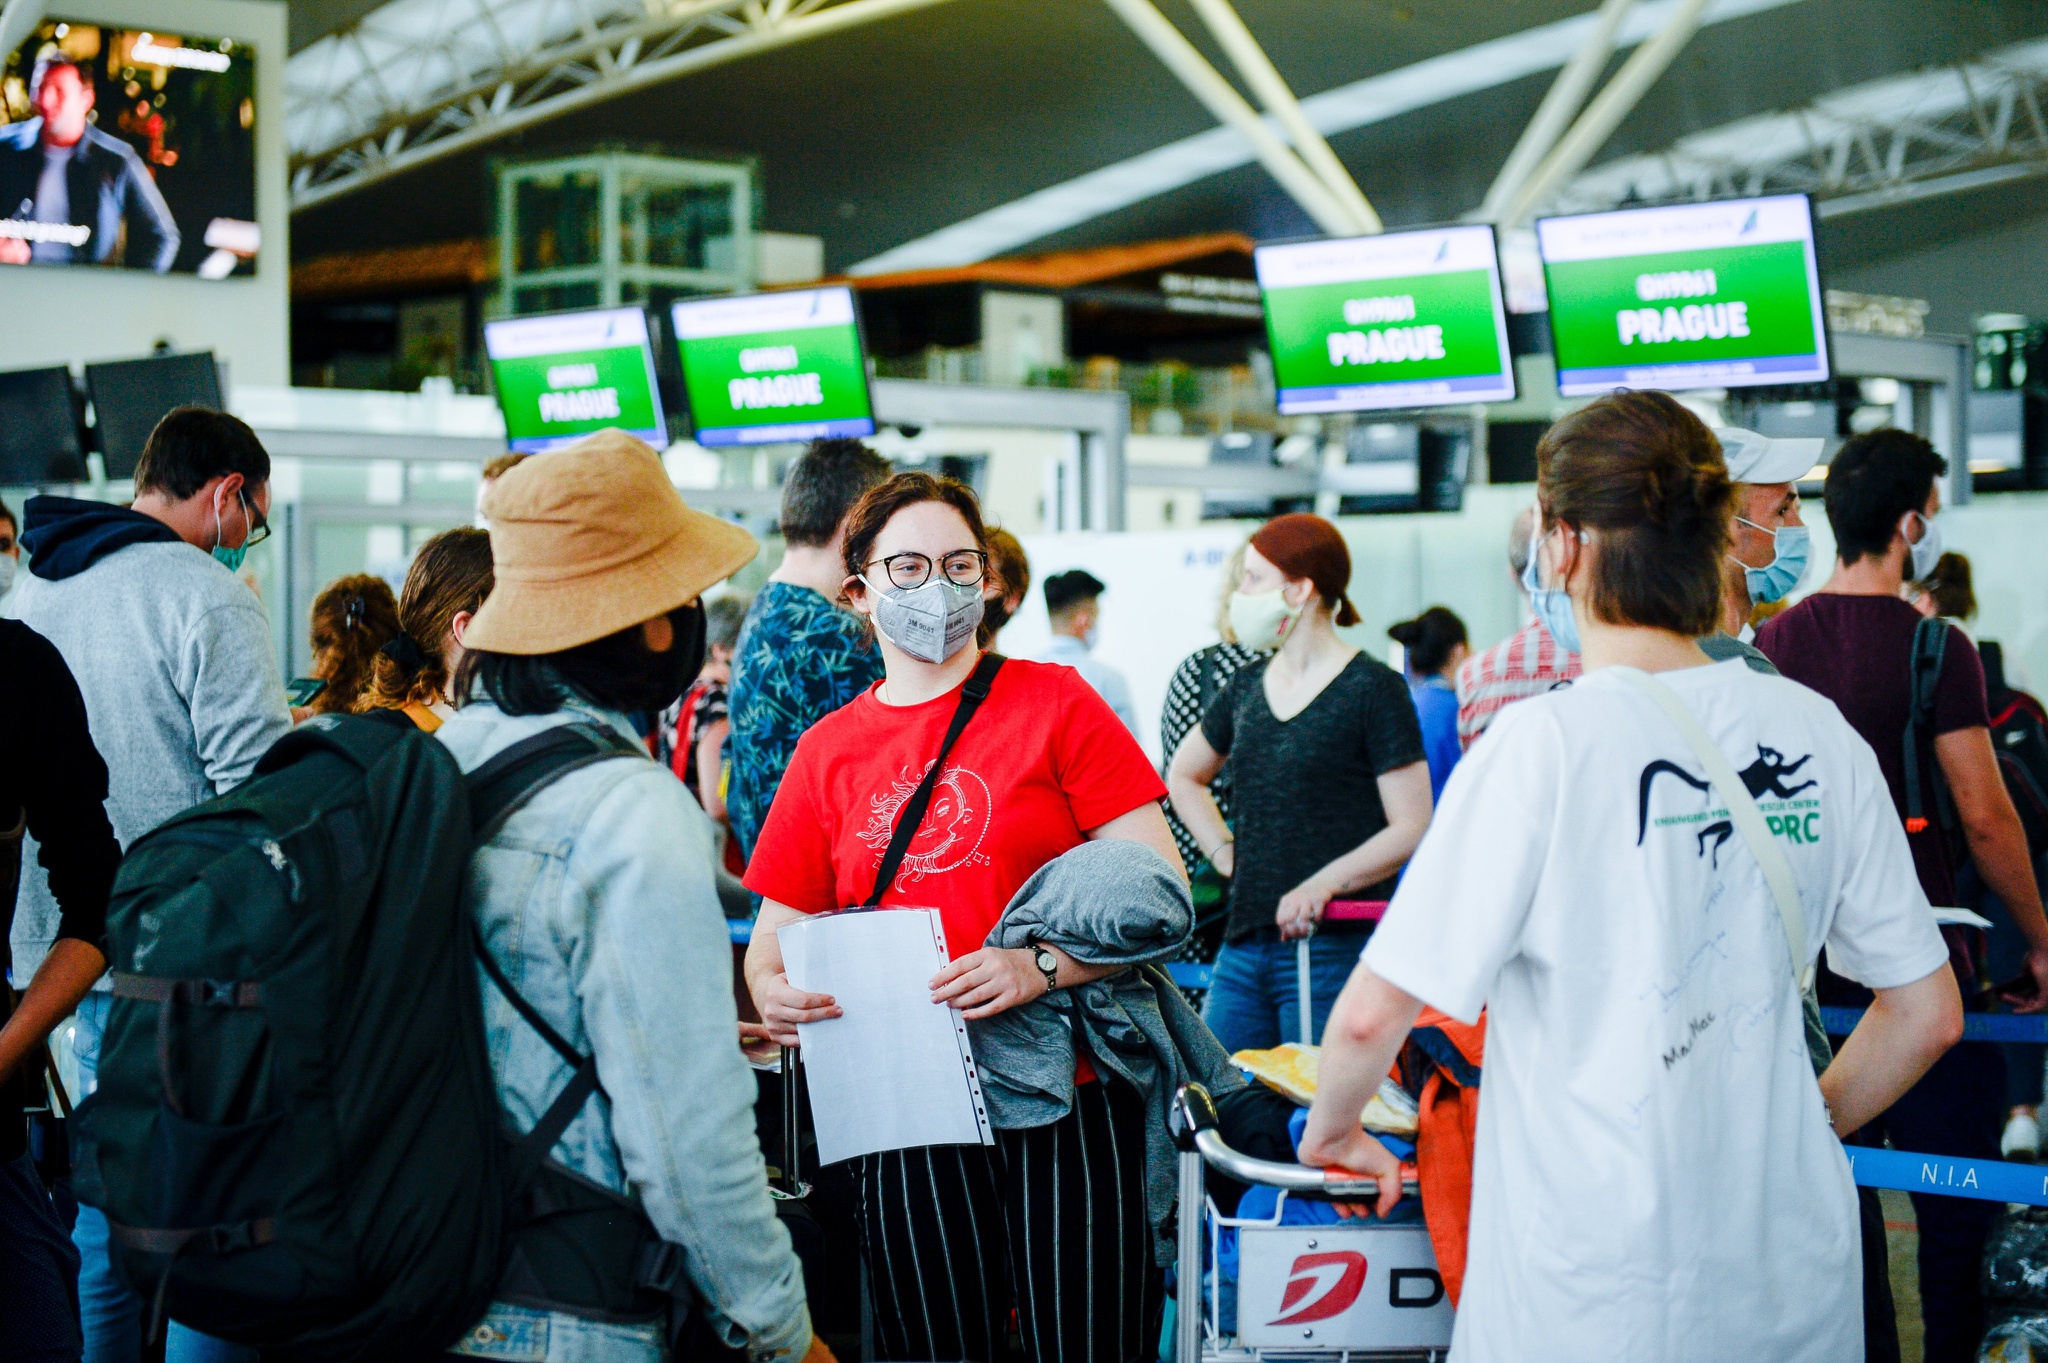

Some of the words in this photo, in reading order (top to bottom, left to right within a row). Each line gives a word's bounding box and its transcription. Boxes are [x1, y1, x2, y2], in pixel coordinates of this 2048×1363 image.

[1617, 301, 1750, 345] PRAGUE
[1327, 325, 1446, 366] PRAGUE
[539, 388, 621, 423] PRAGUE
[729, 373, 824, 410] PRAGUE
[908, 618, 918, 628] 3M
[1921, 1162, 1979, 1190] N.I.A
